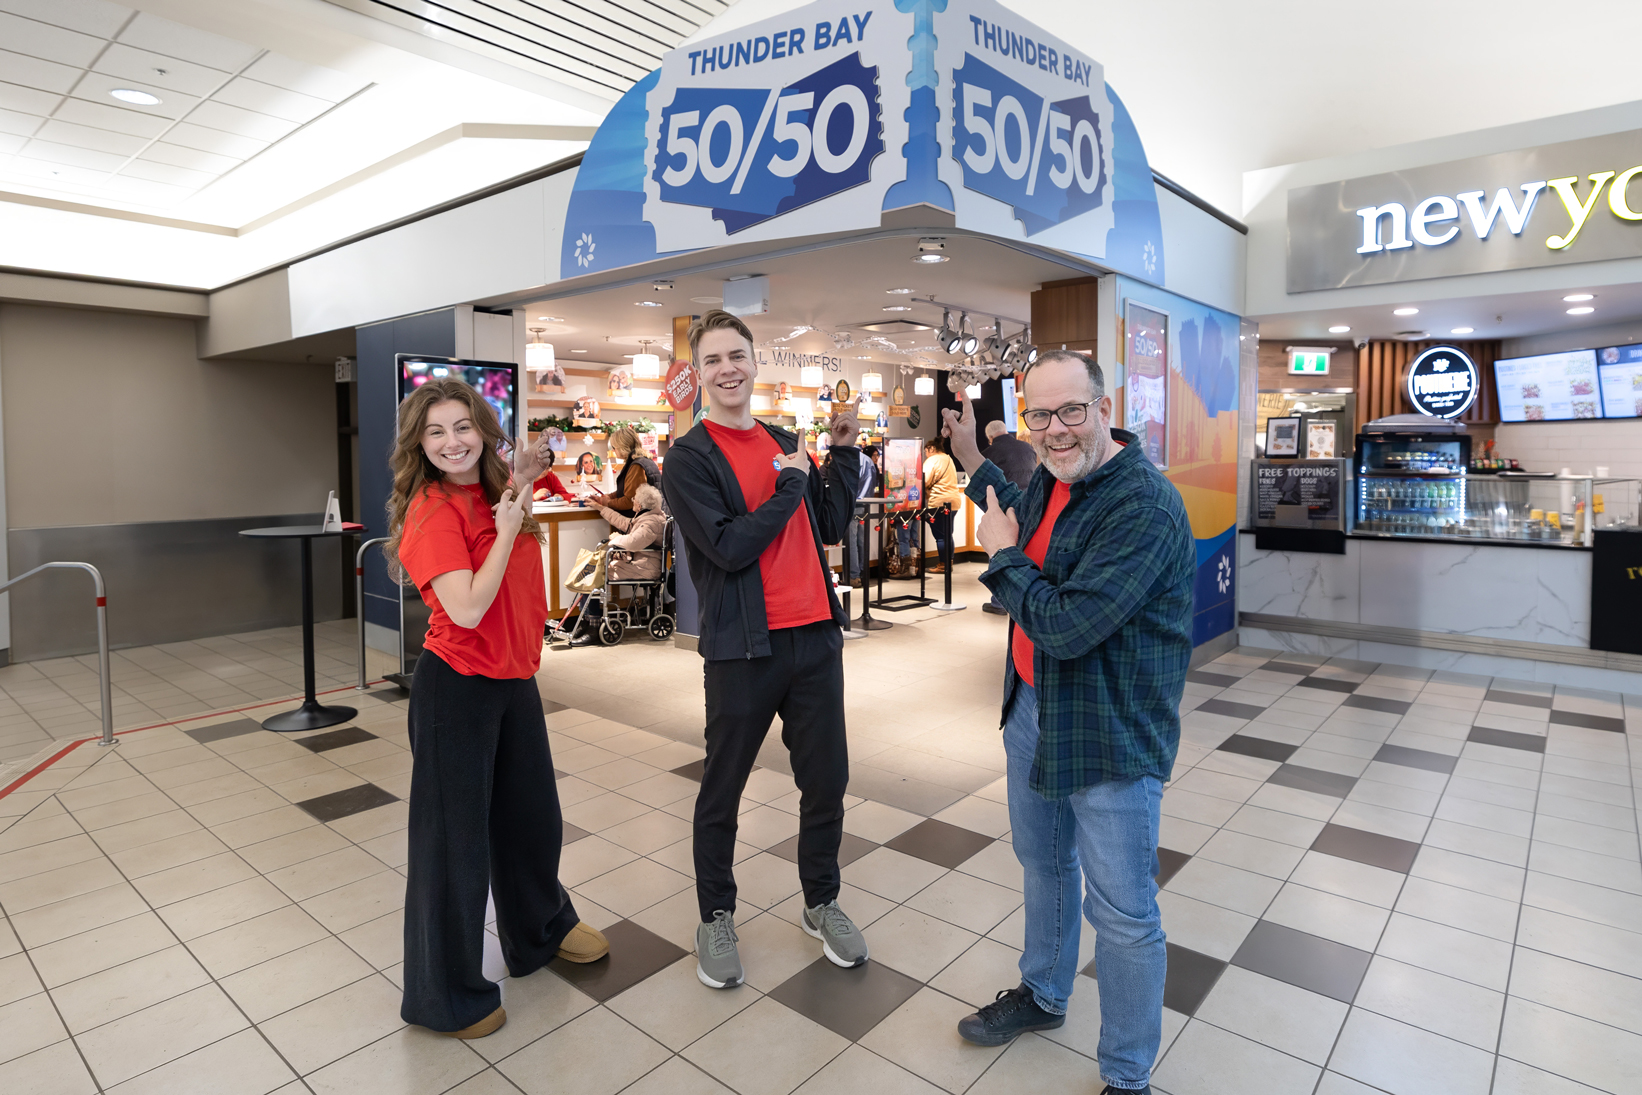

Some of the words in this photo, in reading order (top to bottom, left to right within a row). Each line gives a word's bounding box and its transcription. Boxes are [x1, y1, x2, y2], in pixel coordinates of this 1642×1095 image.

[688, 27, 805, 76] THUNDER
[814, 11, 873, 51] BAY
[969, 14, 1059, 76] THUNDER
[1063, 53, 1092, 87] BAY
[662, 84, 870, 196] 50/50
[962, 82, 1101, 196] 50/50
[1135, 336, 1158, 358] 50/50
[667, 364, 692, 394] $250K
[673, 377, 690, 398] EARLY
[675, 384, 693, 404] BIRDS
[1259, 468, 1284, 477] FREE
[1287, 467, 1337, 477] TOPPINGS
